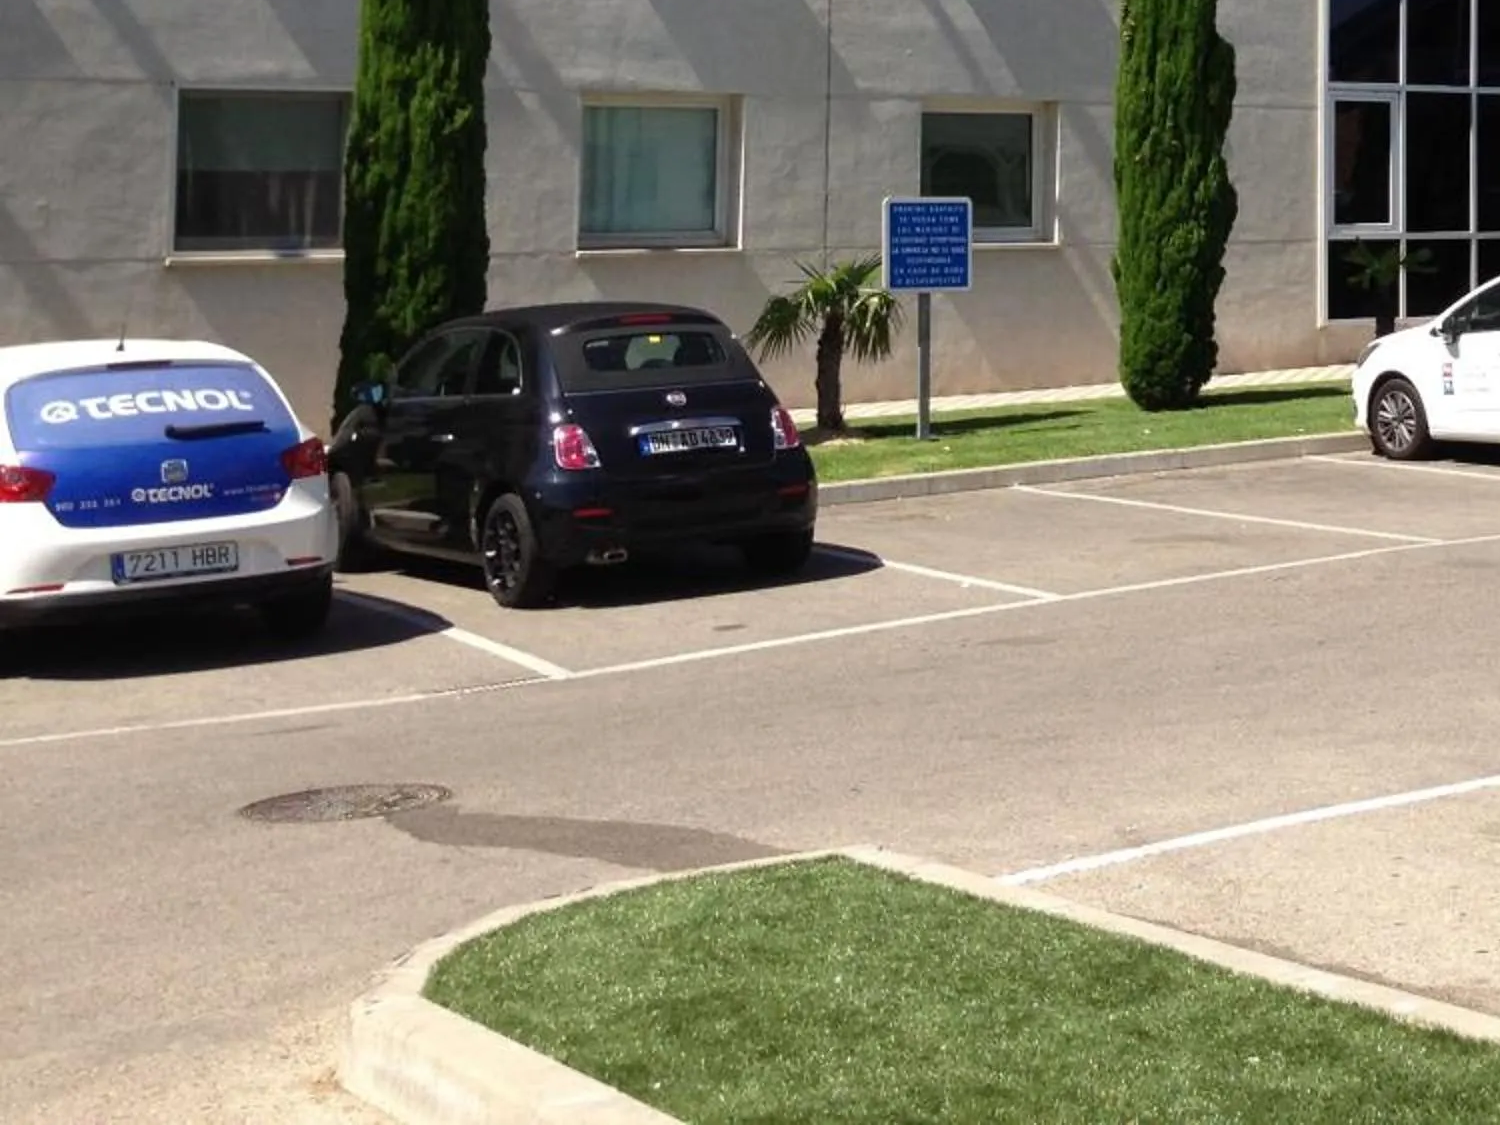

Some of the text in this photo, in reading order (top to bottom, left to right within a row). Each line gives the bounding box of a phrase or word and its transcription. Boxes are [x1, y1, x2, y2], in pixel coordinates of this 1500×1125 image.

[79, 389, 254, 419] TECNOL
[147, 483, 212, 503] TECNOL
[128, 546, 230, 573] 7211 HBR
